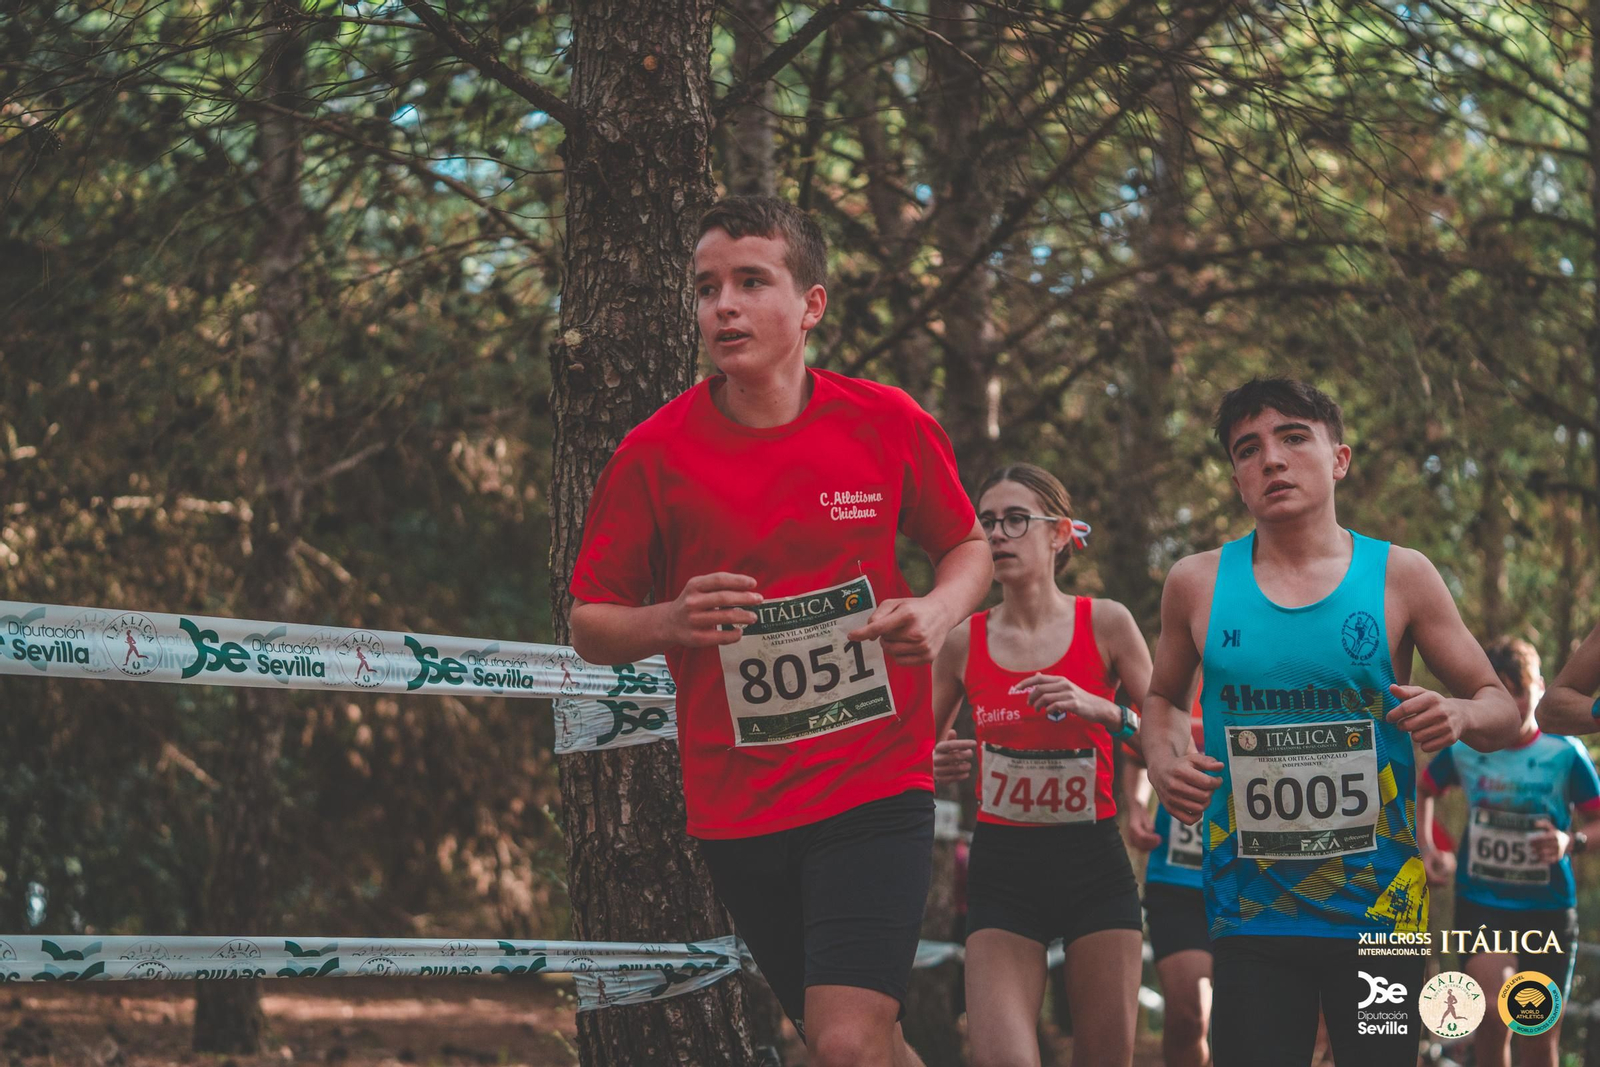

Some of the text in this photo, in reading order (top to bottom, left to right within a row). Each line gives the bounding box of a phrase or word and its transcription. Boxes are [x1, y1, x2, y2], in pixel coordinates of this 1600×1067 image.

[830, 505, 877, 520] Chiclana
[758, 597, 836, 624] ITÁLICA
[8, 621, 86, 640] Diputación
[106, 616, 155, 643] ITÁLICA
[761, 631, 786, 641] AARON
[787, 629, 803, 638] VILA
[770, 629, 831, 646] ATLETISMO CHICLANA
[12, 639, 90, 664] Sevilla
[252, 638, 321, 656] Diputación
[257, 653, 326, 678] Sevilla
[467, 654, 529, 668] Diputación
[473, 667, 534, 689] Sevilla
[739, 640, 875, 704] 8051
[982, 707, 1021, 723] califas
[1266, 728, 1338, 747] ITÁLICA
[1287, 754, 1316, 762] ORTEGA,
[1317, 752, 1348, 761] GONZALO
[990, 770, 1088, 813] 7448
[1246, 773, 1369, 821] 6005
